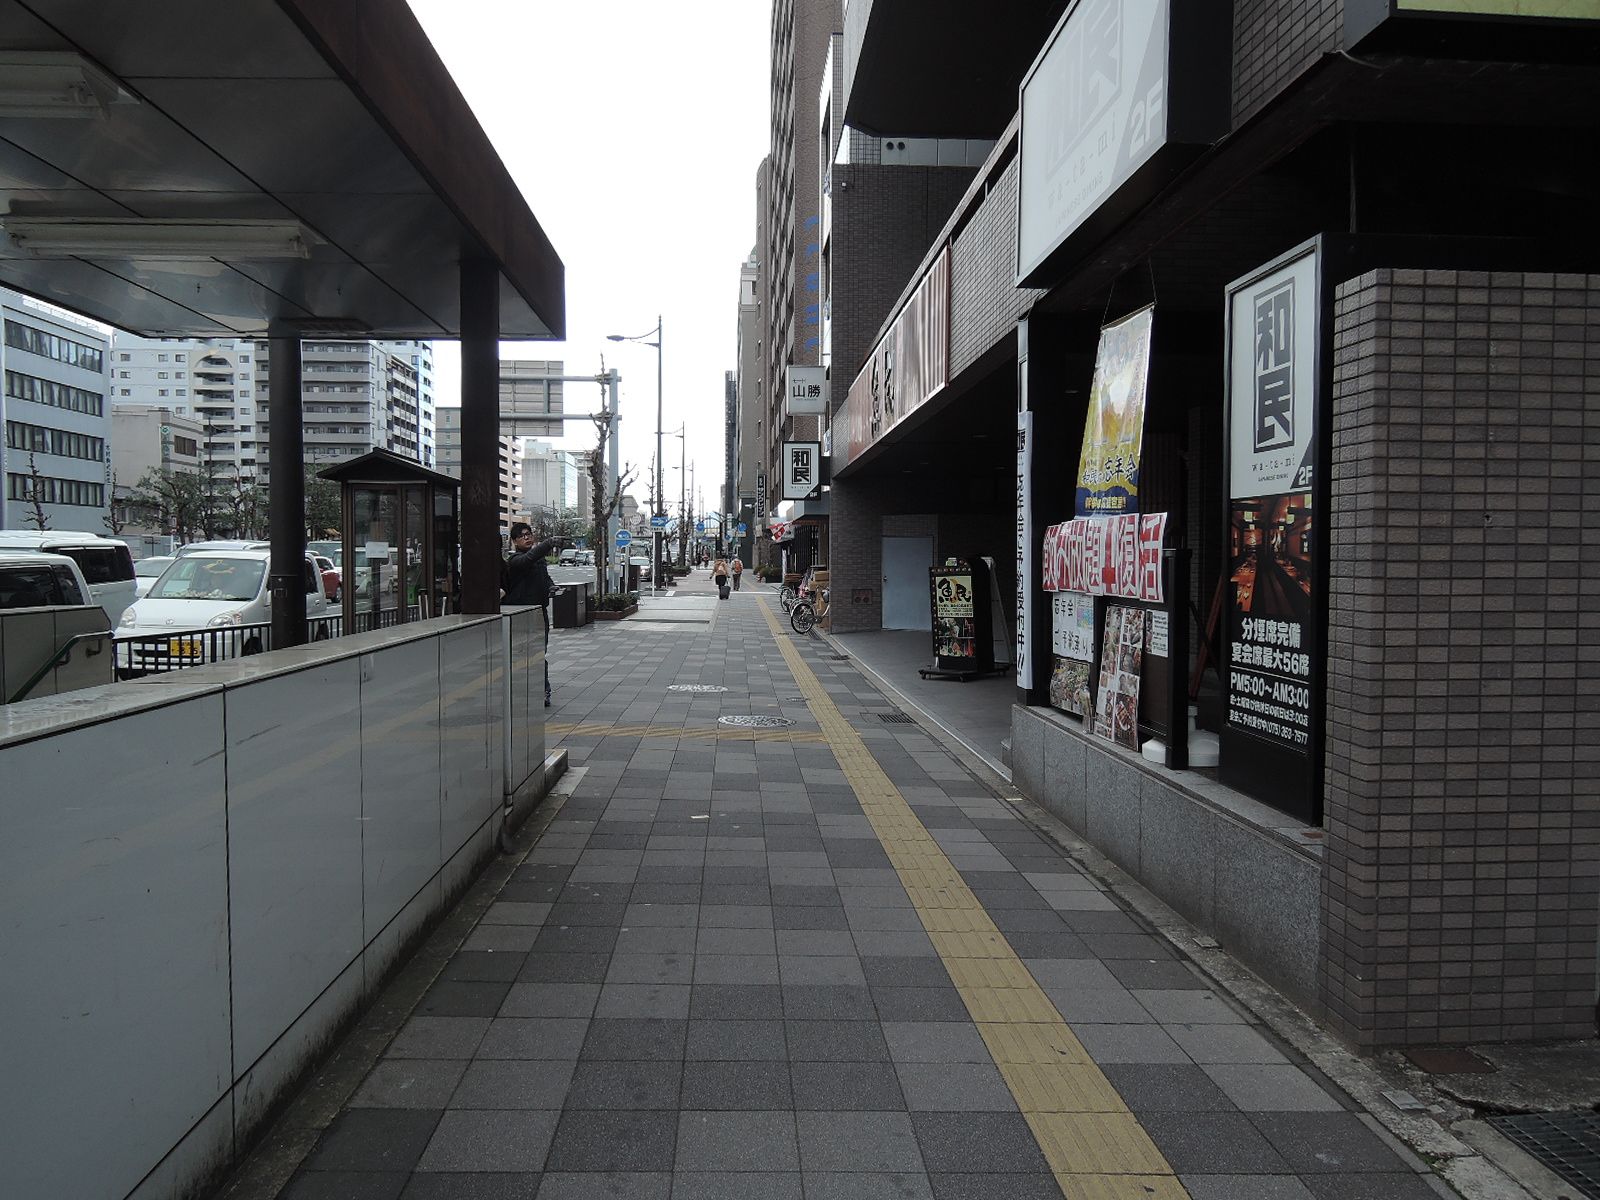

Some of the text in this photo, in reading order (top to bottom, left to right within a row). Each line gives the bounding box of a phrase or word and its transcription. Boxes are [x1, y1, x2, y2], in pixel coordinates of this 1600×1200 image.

[1128, 78, 1162, 158] 2F
[1257, 289, 1291, 445] 和民
[793, 385, 820, 398] 山勝
[793, 450, 810, 483] 和民
[1299, 465, 1312, 486] 2F
[1241, 617, 1301, 649] 分煙席完備
[1231, 642, 1310, 677] 宴会席最大56席
